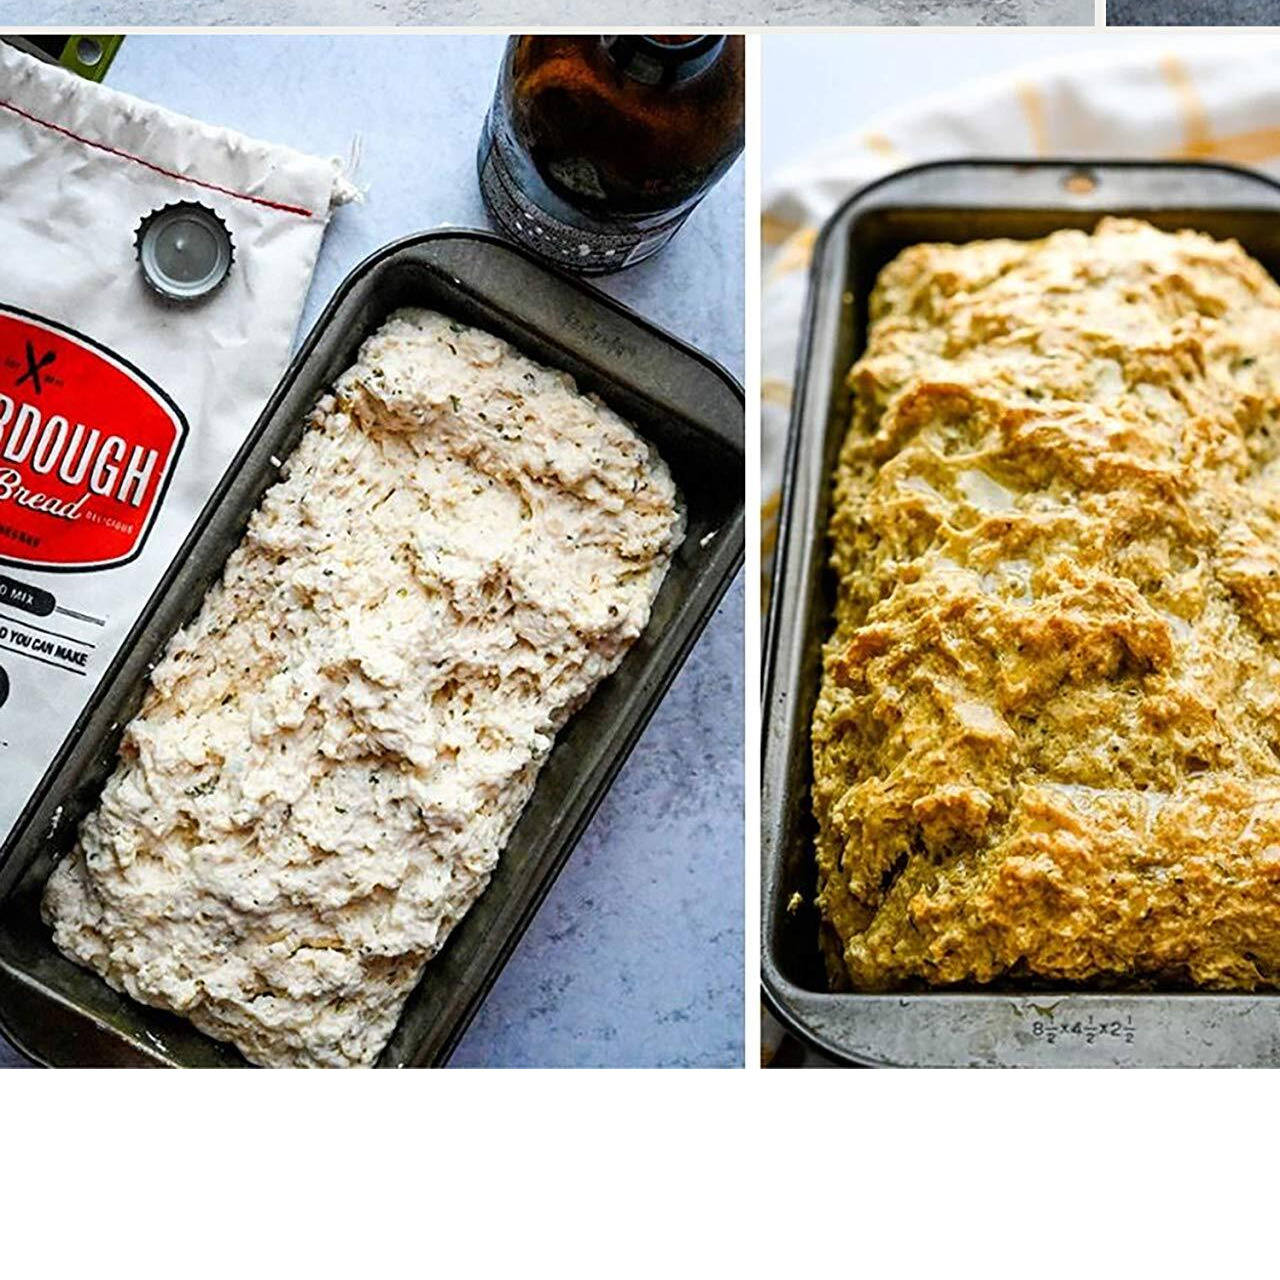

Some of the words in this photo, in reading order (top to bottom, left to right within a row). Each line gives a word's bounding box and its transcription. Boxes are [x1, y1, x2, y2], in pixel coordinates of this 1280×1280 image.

[9, 588, 35, 606] MIX
[9, 629, 33, 648] YOU
[30, 637, 55, 656] CAN
[53, 644, 89, 668] MAKE
